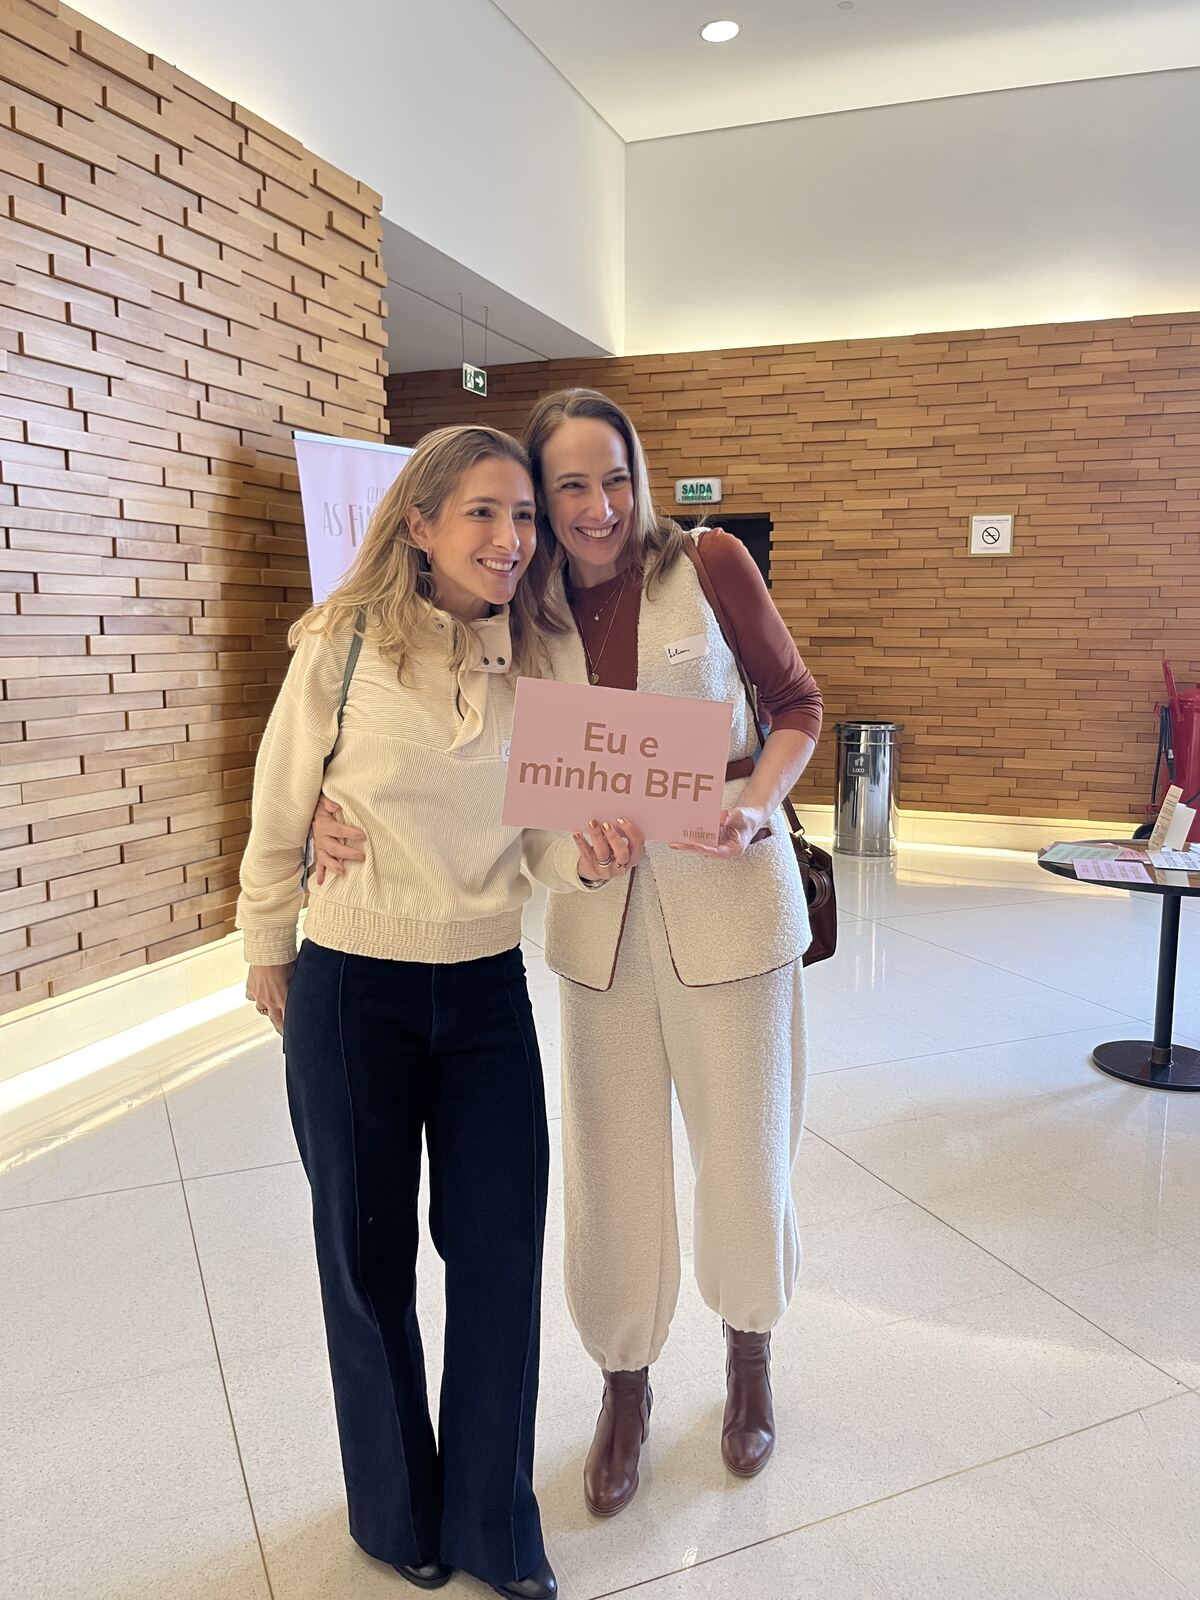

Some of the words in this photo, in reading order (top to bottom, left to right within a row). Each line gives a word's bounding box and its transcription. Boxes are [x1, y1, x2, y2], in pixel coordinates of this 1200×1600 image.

[682, 482, 712, 494] SAÍDA
[323, 502, 343, 537] AS
[584, 722, 627, 755] Eu
[640, 735, 659, 758] e
[519, 757, 632, 795] minha
[644, 768, 714, 802] BFF
